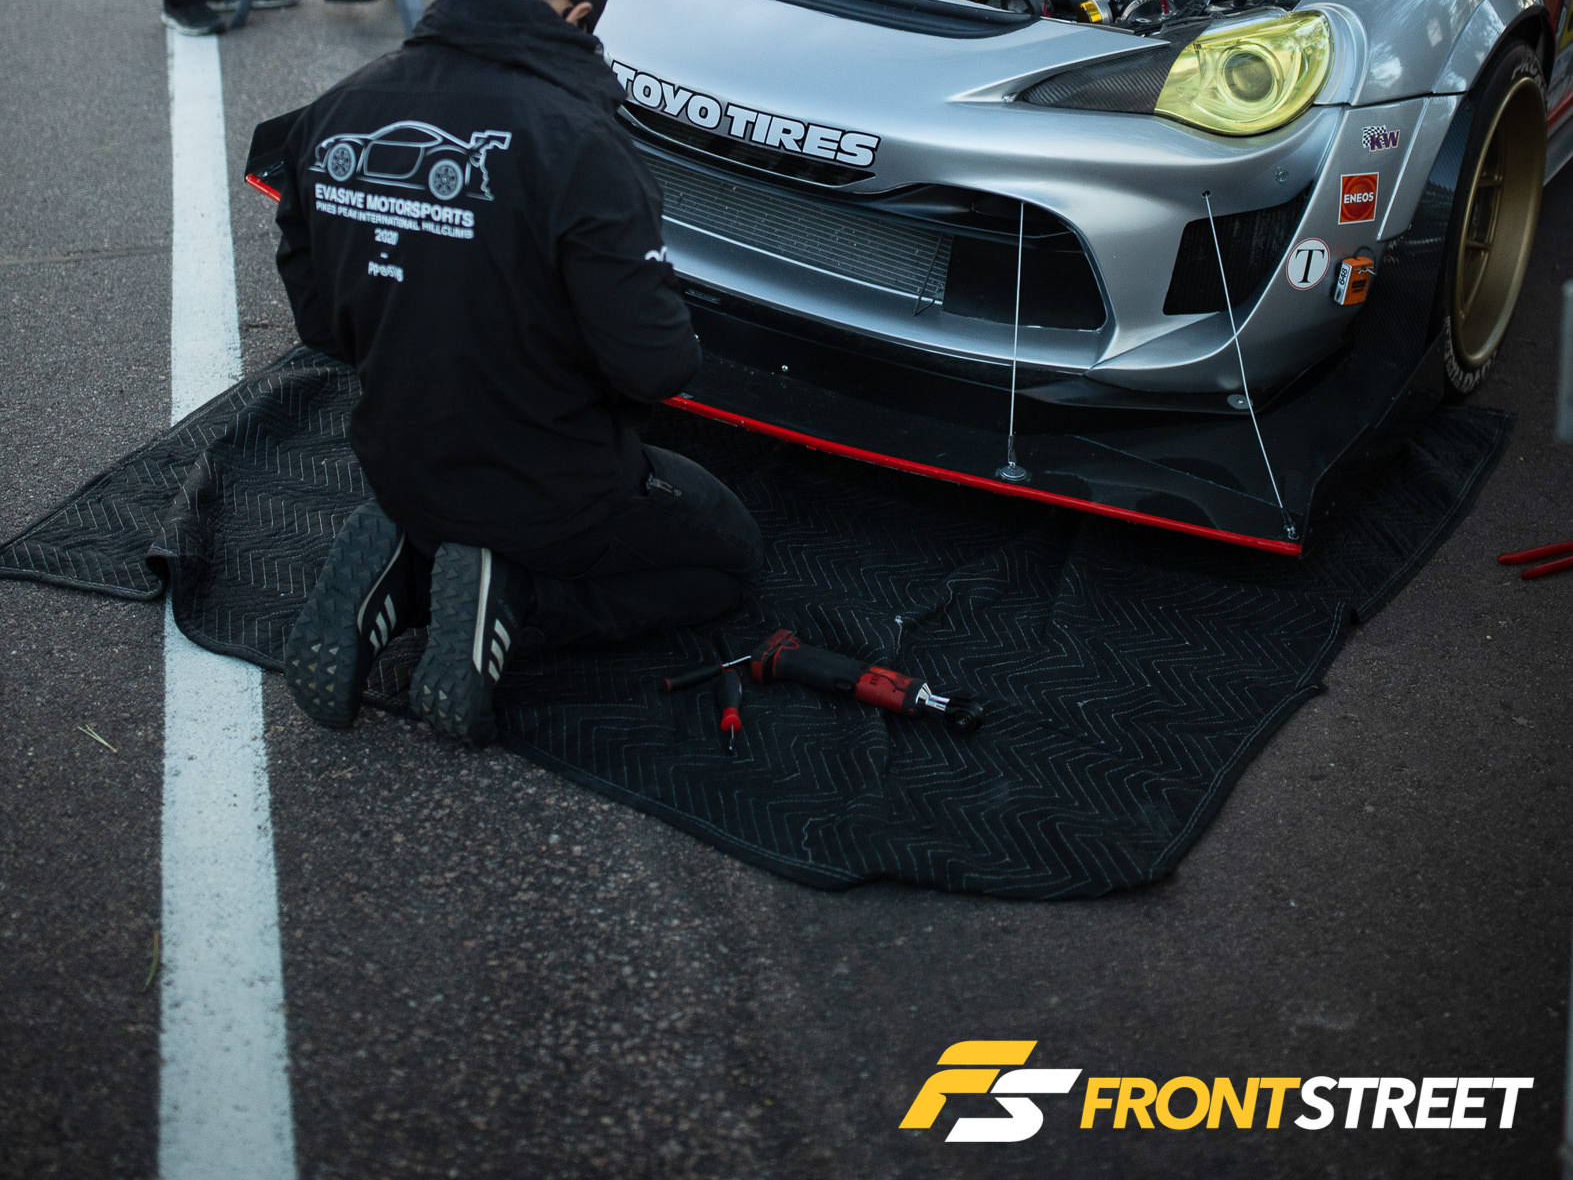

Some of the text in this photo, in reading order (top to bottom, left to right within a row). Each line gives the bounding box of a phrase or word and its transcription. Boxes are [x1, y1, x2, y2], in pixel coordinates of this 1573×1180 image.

[611, 59, 882, 168] TOYO TIRES
[1369, 130, 1400, 152] KW
[315, 182, 475, 228] EVASIVE MOTORSPORTS
[315, 200, 337, 215] PIKES
[1343, 191, 1375, 204] ENEOS
[1294, 248, 1326, 284] T
